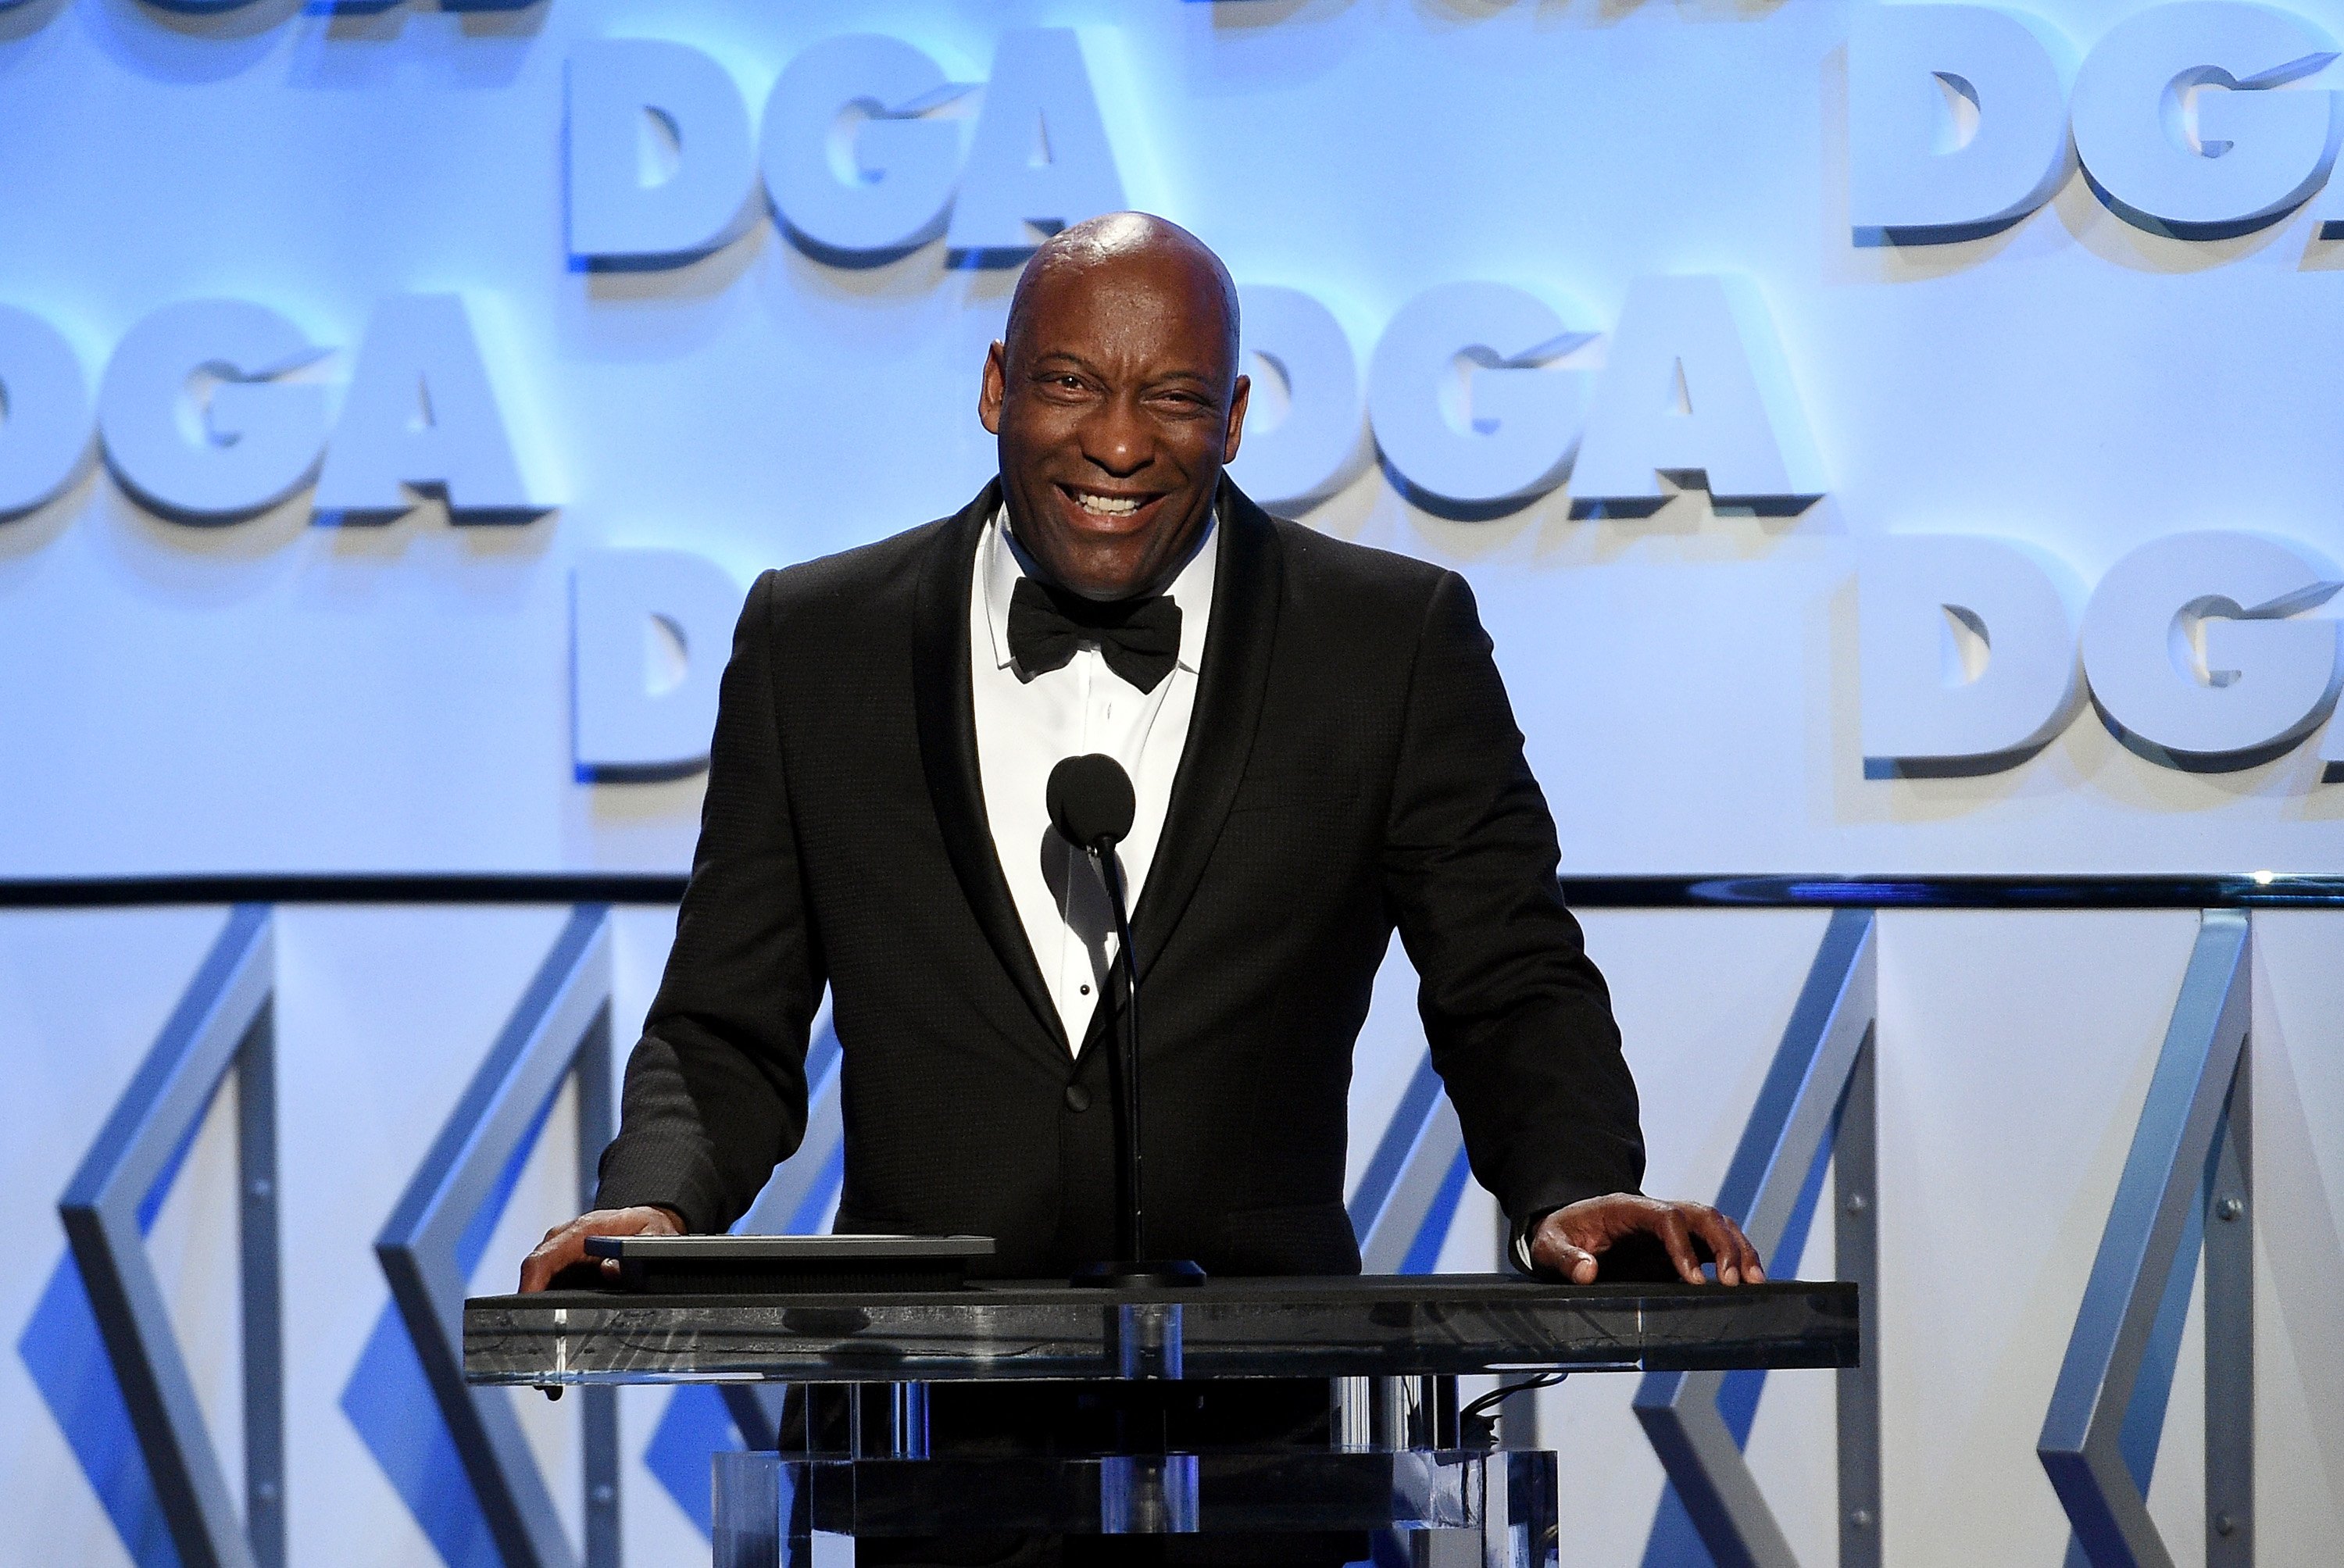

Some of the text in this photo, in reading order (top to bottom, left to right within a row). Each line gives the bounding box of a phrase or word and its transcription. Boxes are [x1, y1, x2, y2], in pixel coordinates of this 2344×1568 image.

[564, 27, 1134, 273] DGA
[1849, 2, 2344, 248] DG
[1860, 531, 2344, 781] DG
